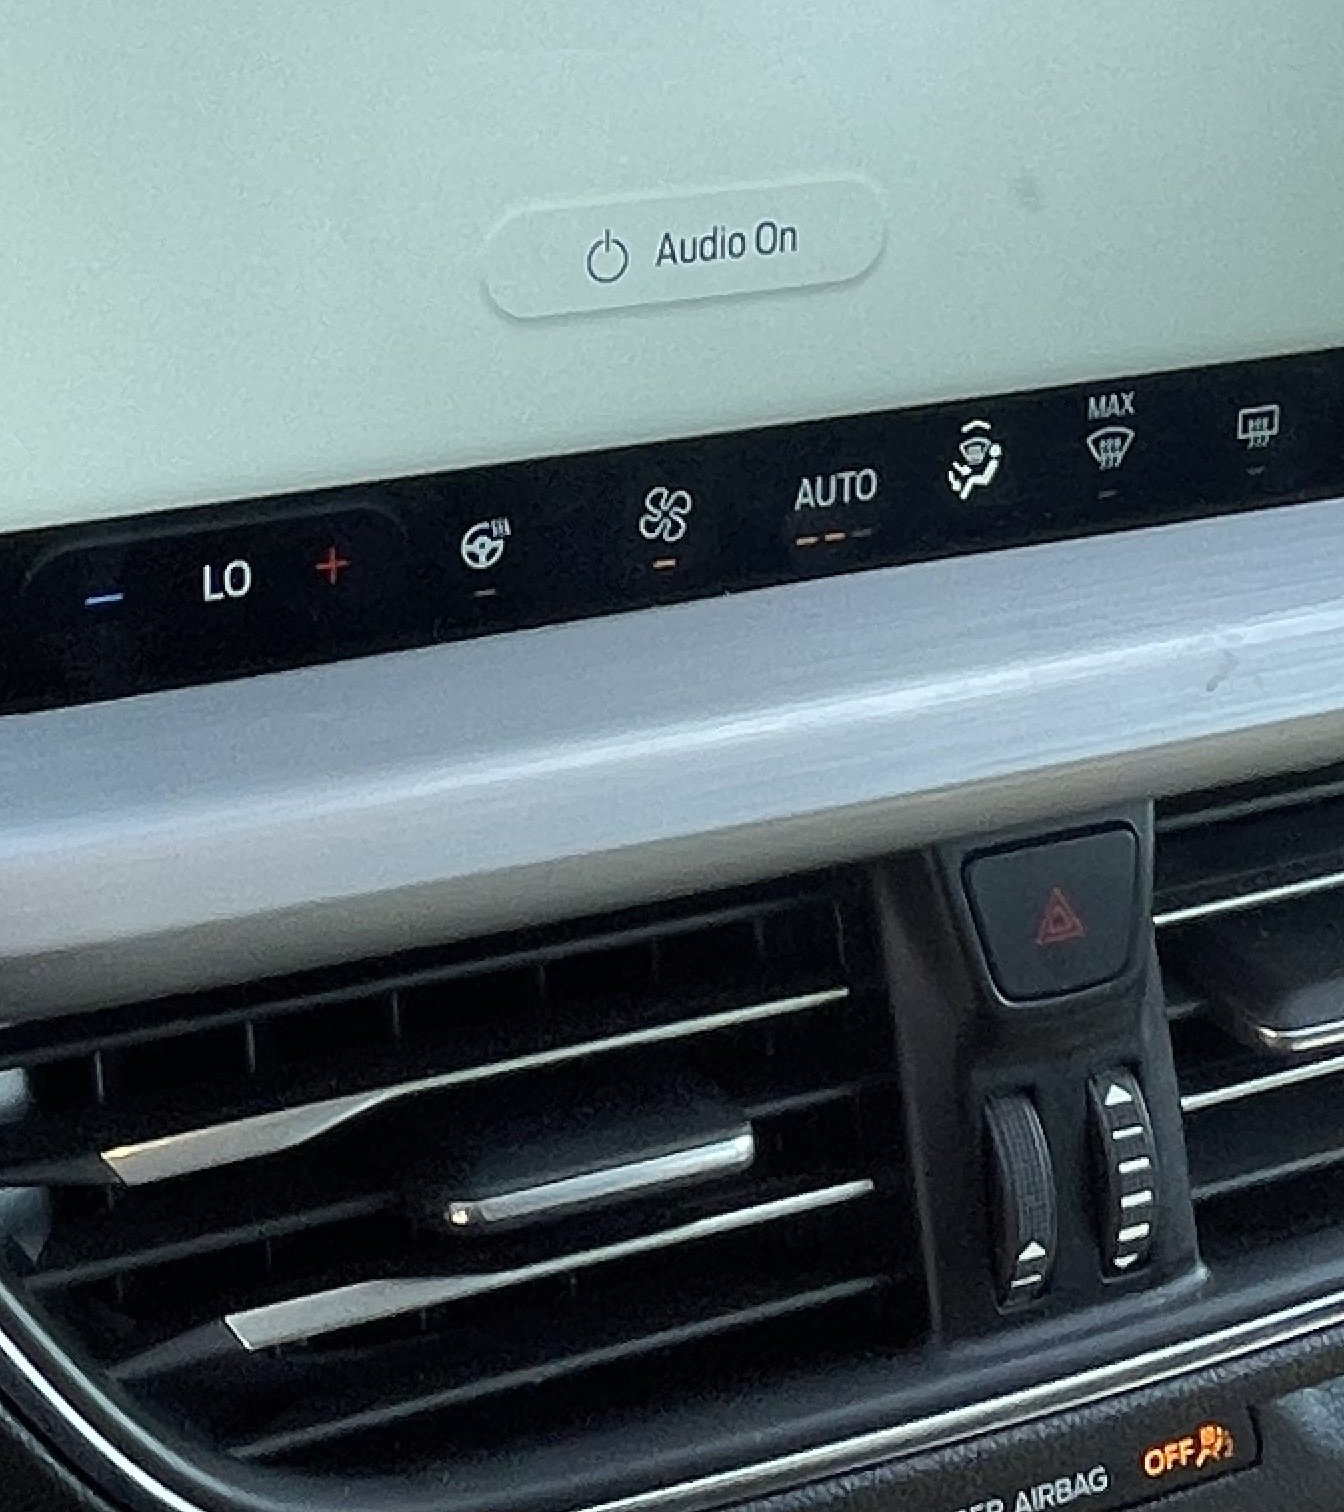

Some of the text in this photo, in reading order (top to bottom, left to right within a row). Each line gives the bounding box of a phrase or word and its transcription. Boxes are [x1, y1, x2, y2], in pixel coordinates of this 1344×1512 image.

[656, 221, 797, 267] Audio On
[1088, 392, 1135, 419] MAX
[795, 468, 878, 511] AUTO
[203, 559, 252, 602] LO
[1144, 1438, 1194, 1476] OFF
[1013, 1465, 1108, 1512] AIRBAG
